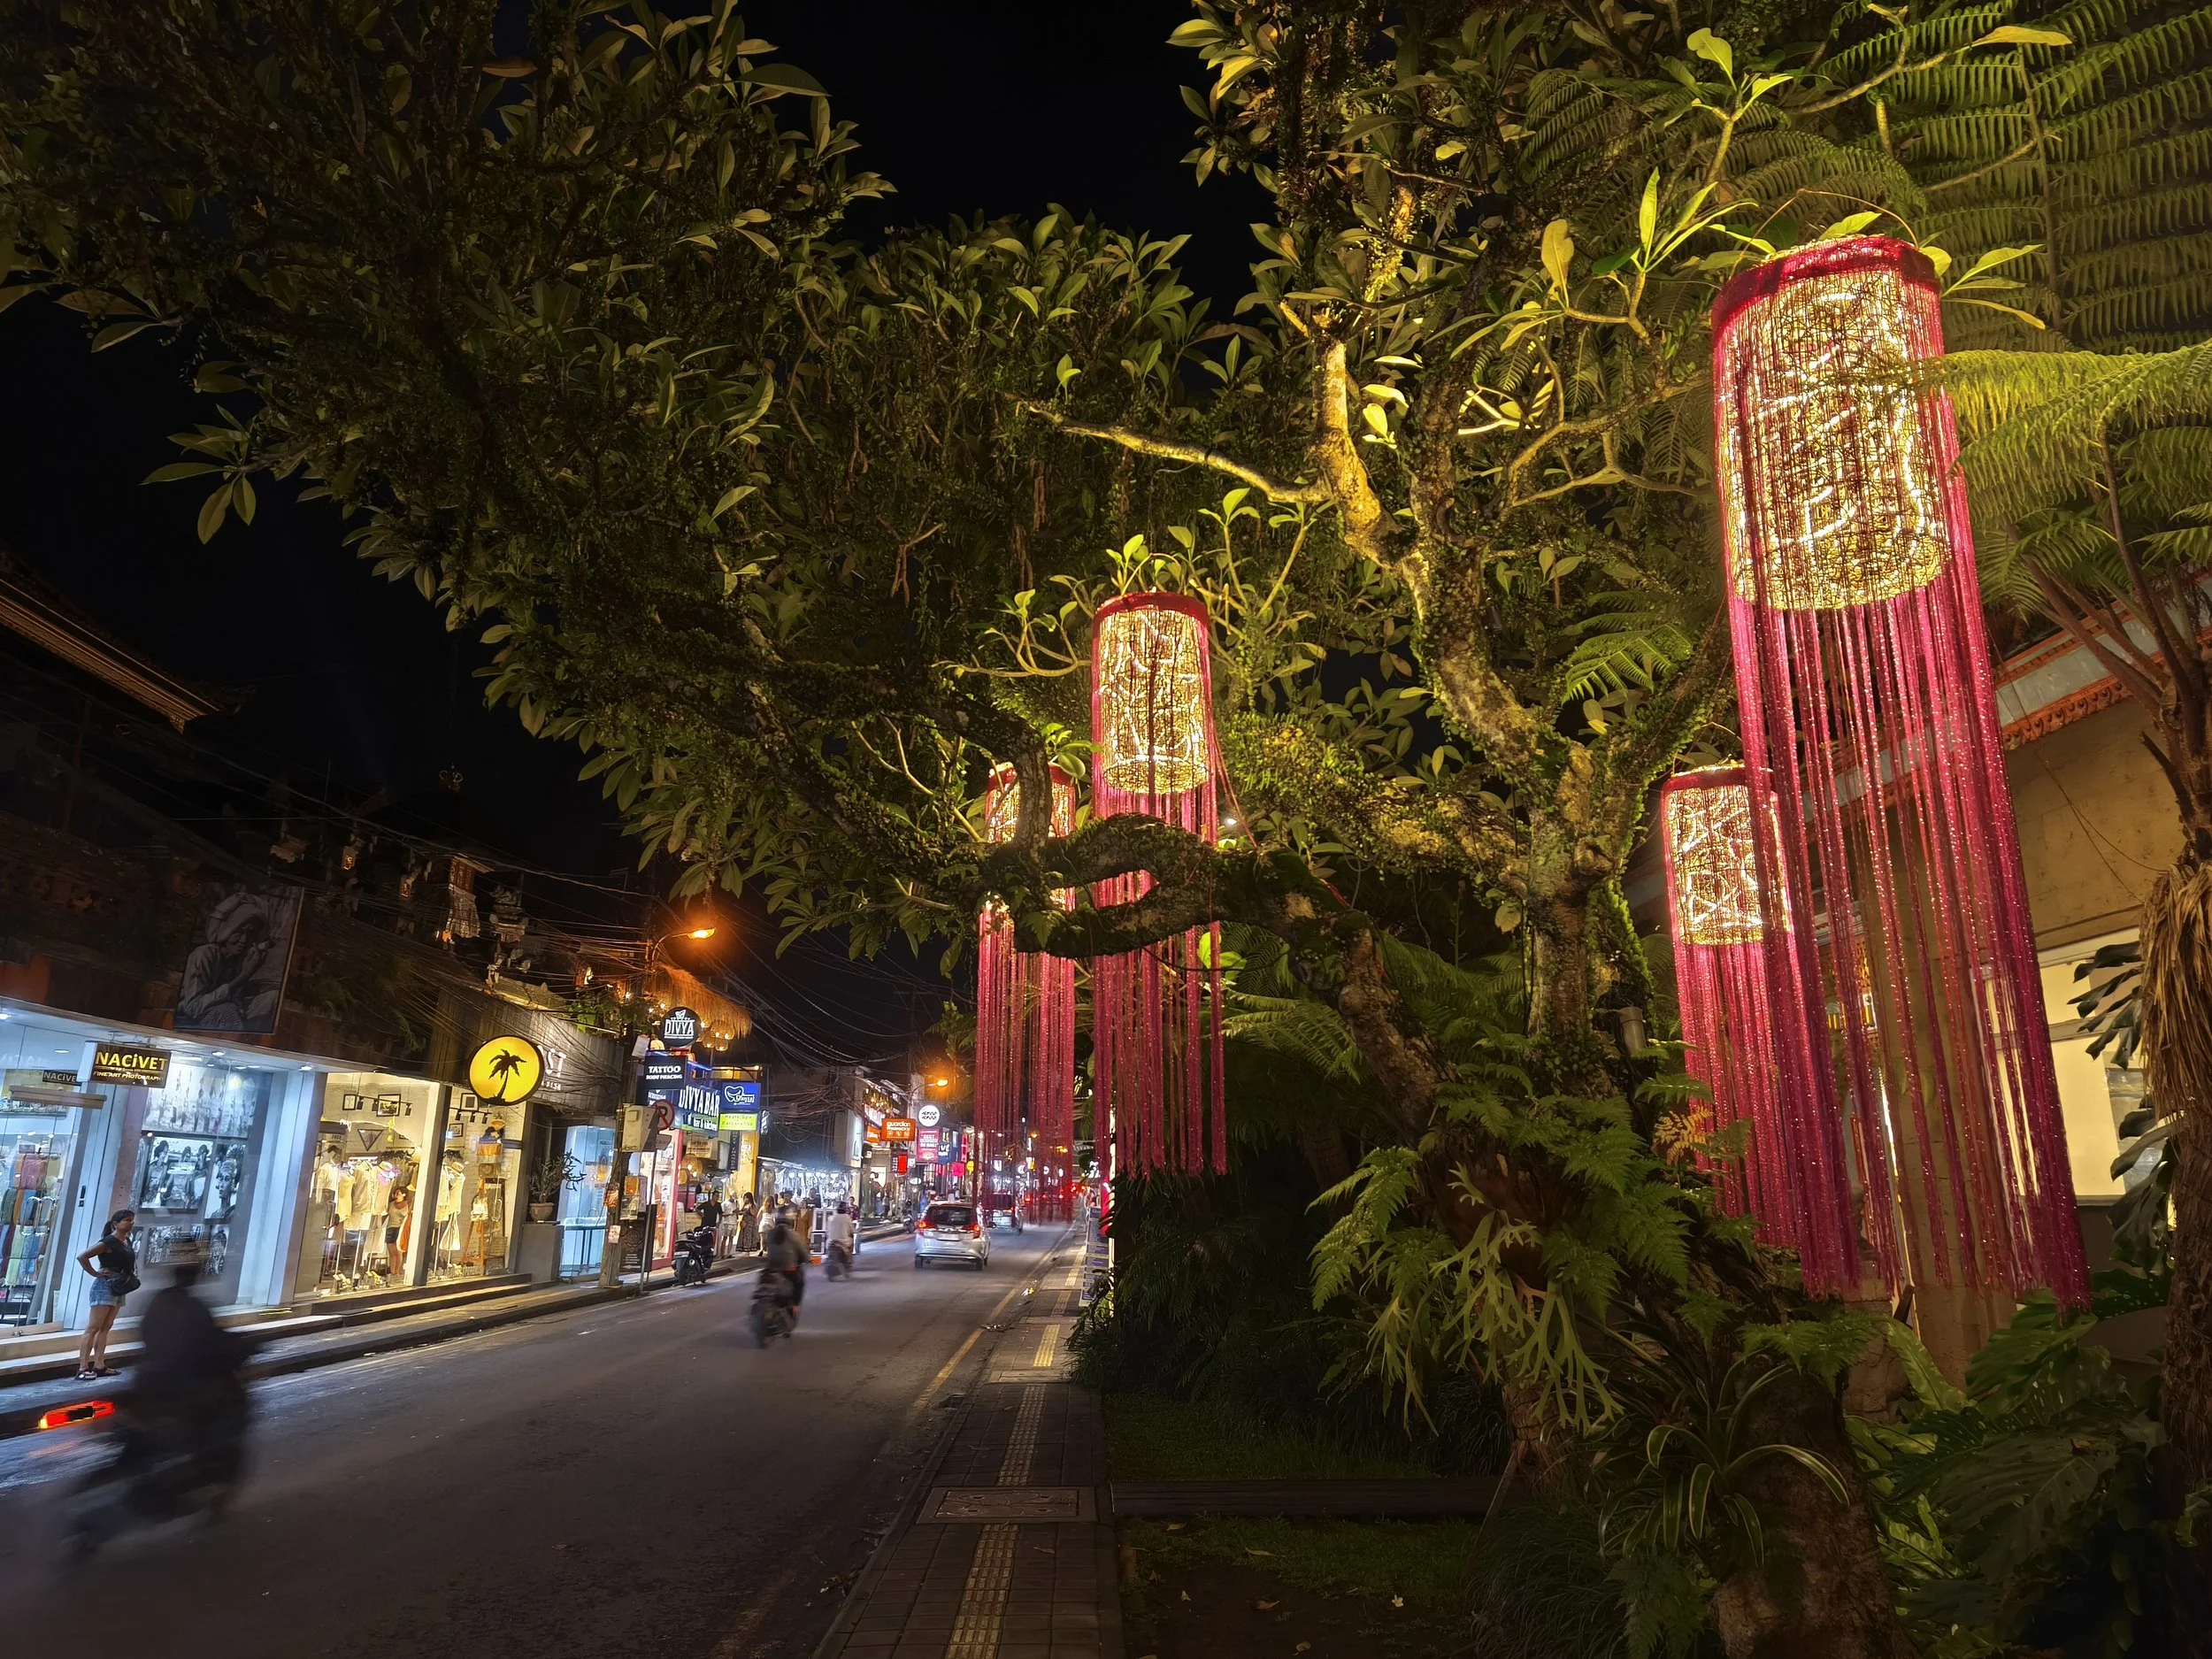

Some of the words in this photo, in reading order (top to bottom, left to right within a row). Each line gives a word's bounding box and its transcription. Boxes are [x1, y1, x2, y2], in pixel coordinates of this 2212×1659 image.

[664, 1019, 695, 1034] DIVYA
[43, 1071, 78, 1082] NACiVE
[679, 1086, 704, 1114] DIVYA
[703, 1092, 720, 1118] BAR
